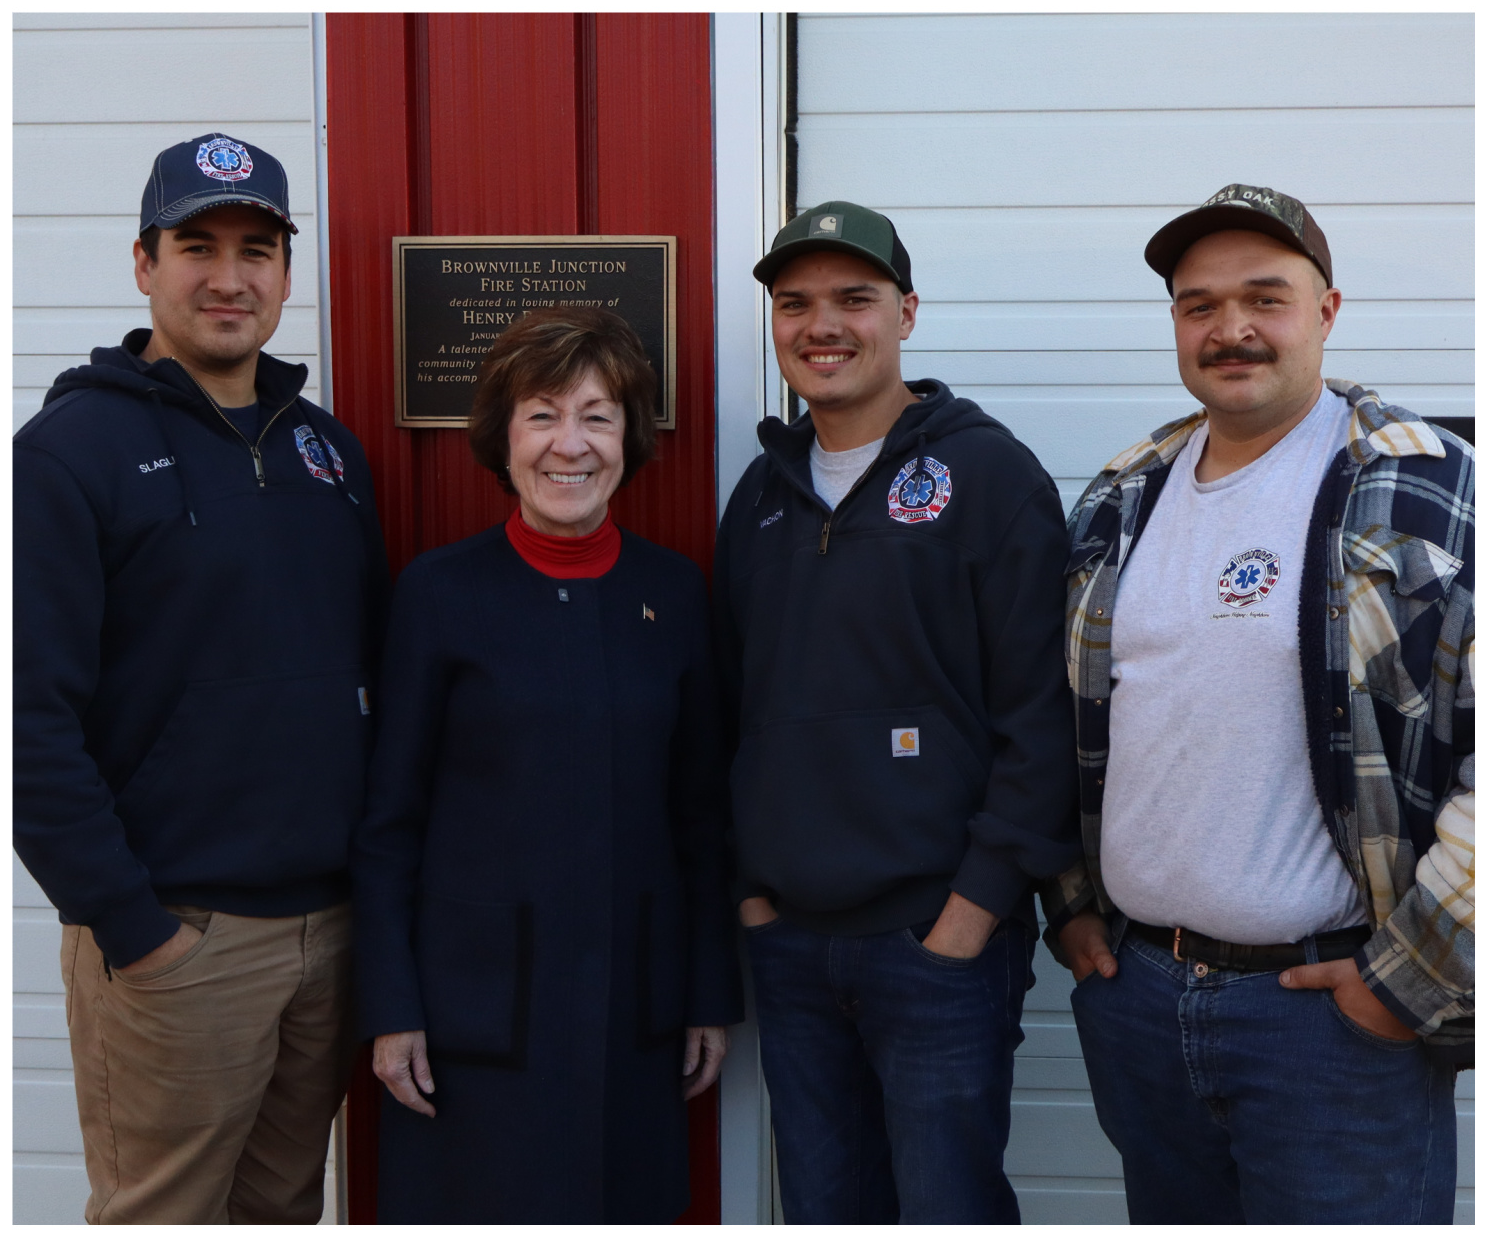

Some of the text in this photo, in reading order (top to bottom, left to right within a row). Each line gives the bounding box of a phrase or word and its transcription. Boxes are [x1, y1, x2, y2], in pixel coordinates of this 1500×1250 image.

[1243, 191, 1274, 206] OAK
[441, 259, 627, 274] BROWNVILLE JUNCTION
[480, 277, 587, 292] FIRE STATION
[449, 297, 620, 308] dedicated in loving memory of
[462, 310, 515, 325] HENRY
[470, 332, 504, 341] JANUAR
[438, 345, 446, 353] A
[418, 358, 476, 369] community
[417, 372, 433, 382] his
